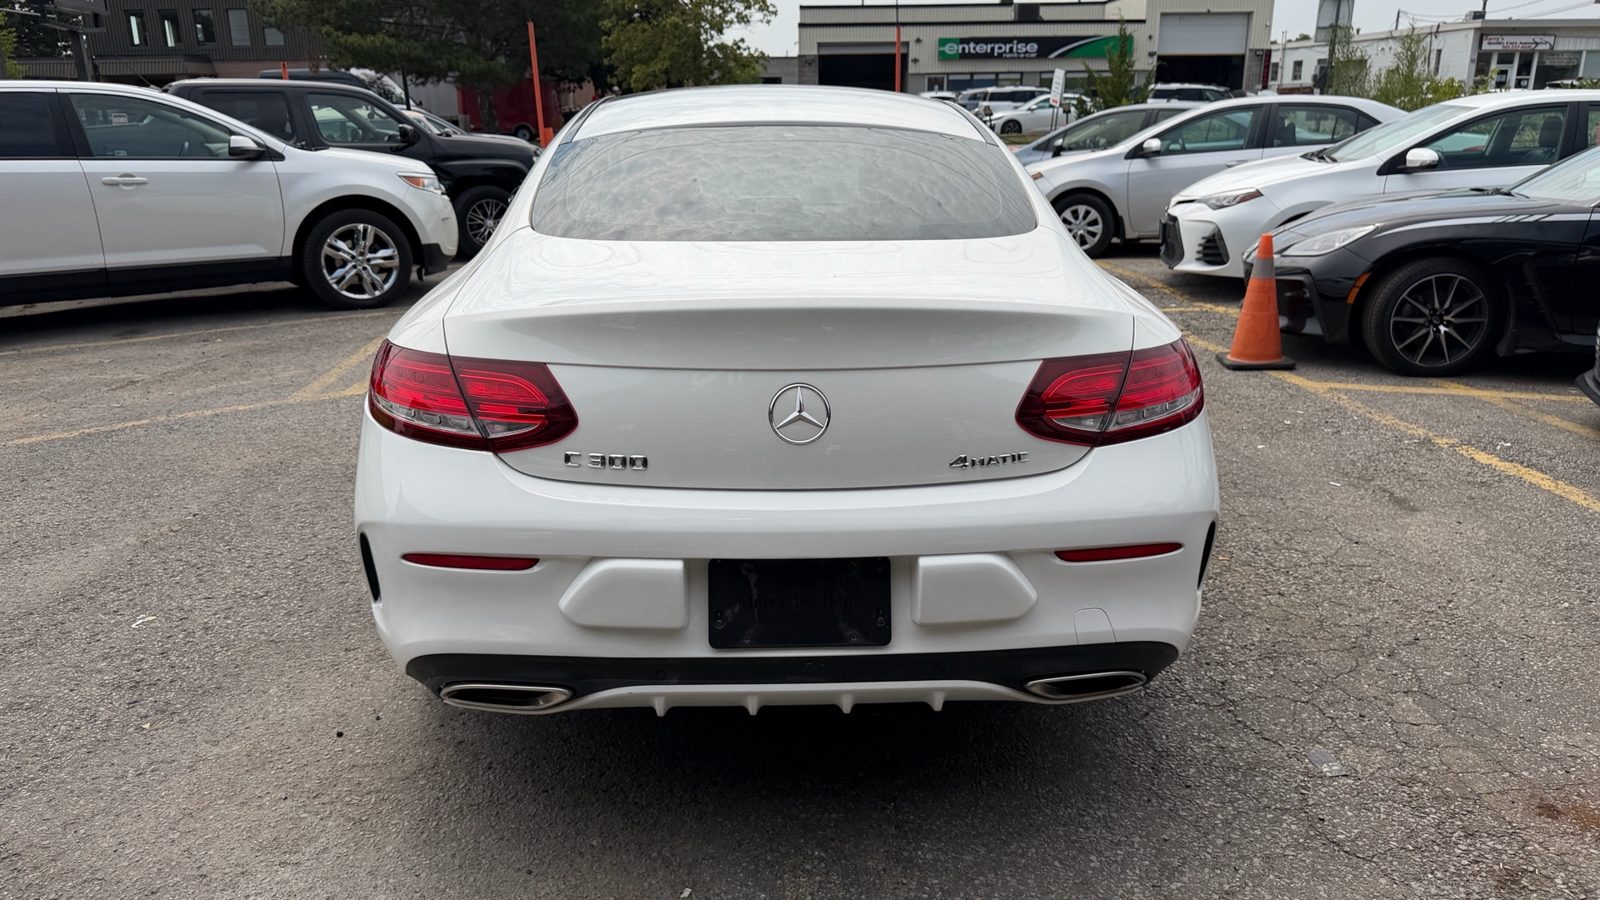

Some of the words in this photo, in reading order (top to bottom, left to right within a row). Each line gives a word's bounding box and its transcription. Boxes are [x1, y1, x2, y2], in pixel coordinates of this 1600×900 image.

[943, 40, 1038, 56] enterprise
[564, 451, 581, 467] C
[588, 453, 648, 471] 300
[949, 451, 1029, 468] 4MATIC
